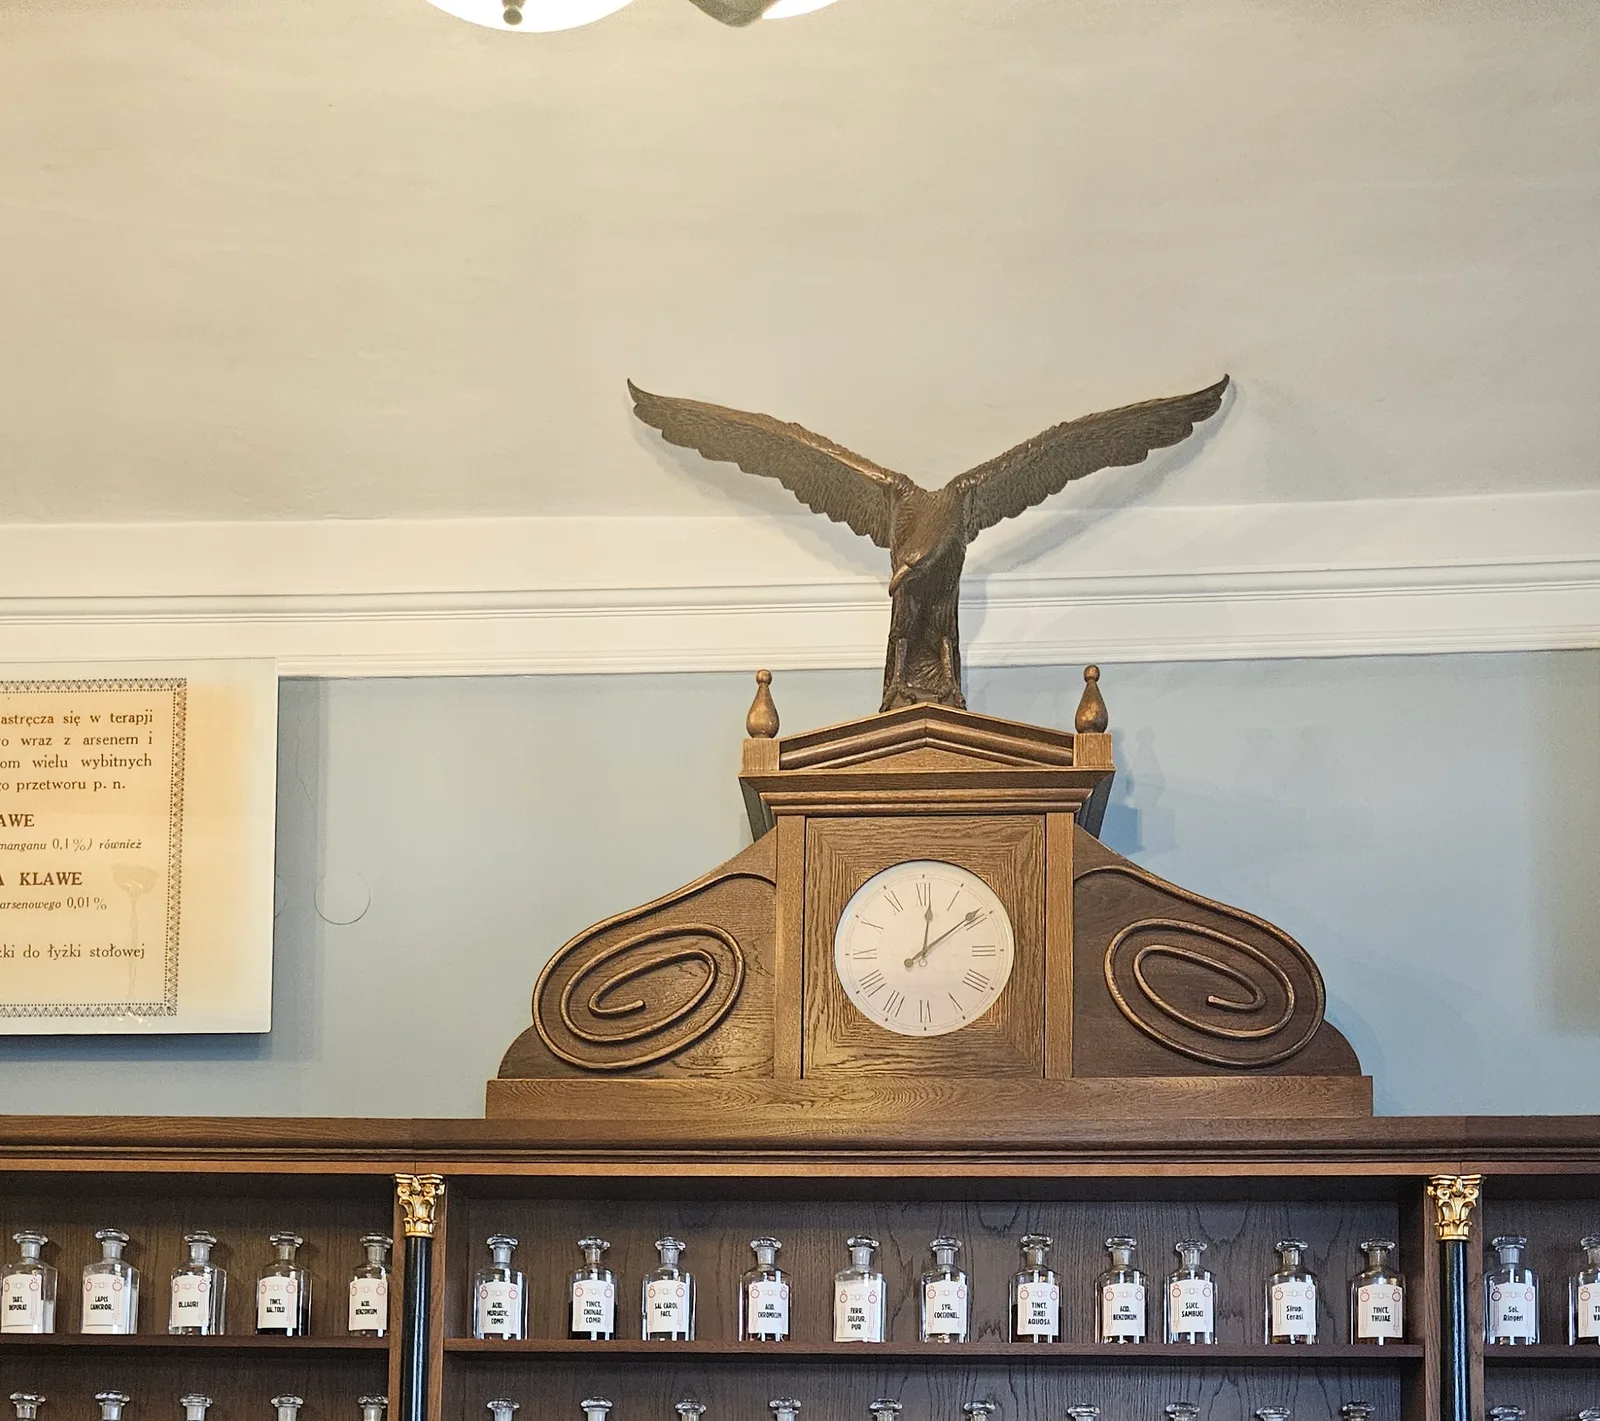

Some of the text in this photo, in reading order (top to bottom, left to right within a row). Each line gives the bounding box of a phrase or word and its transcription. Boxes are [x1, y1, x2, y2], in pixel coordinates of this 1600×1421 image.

[63, 710, 80, 726] się
[90, 715, 101, 723] w
[110, 709, 152, 725] terapji
[0, 730, 152, 747] o wraz z arsenem i
[32, 754, 68, 768] wielu
[81, 753, 152, 770] wybitnych
[0, 780, 126, 793] o przetworu p. n.
[99, 838, 142, 849] również
[20, 872, 82, 886] KLAWE
[23, 944, 40, 958] do
[90, 943, 145, 960] stołowej
[972, 945, 996, 957] III
